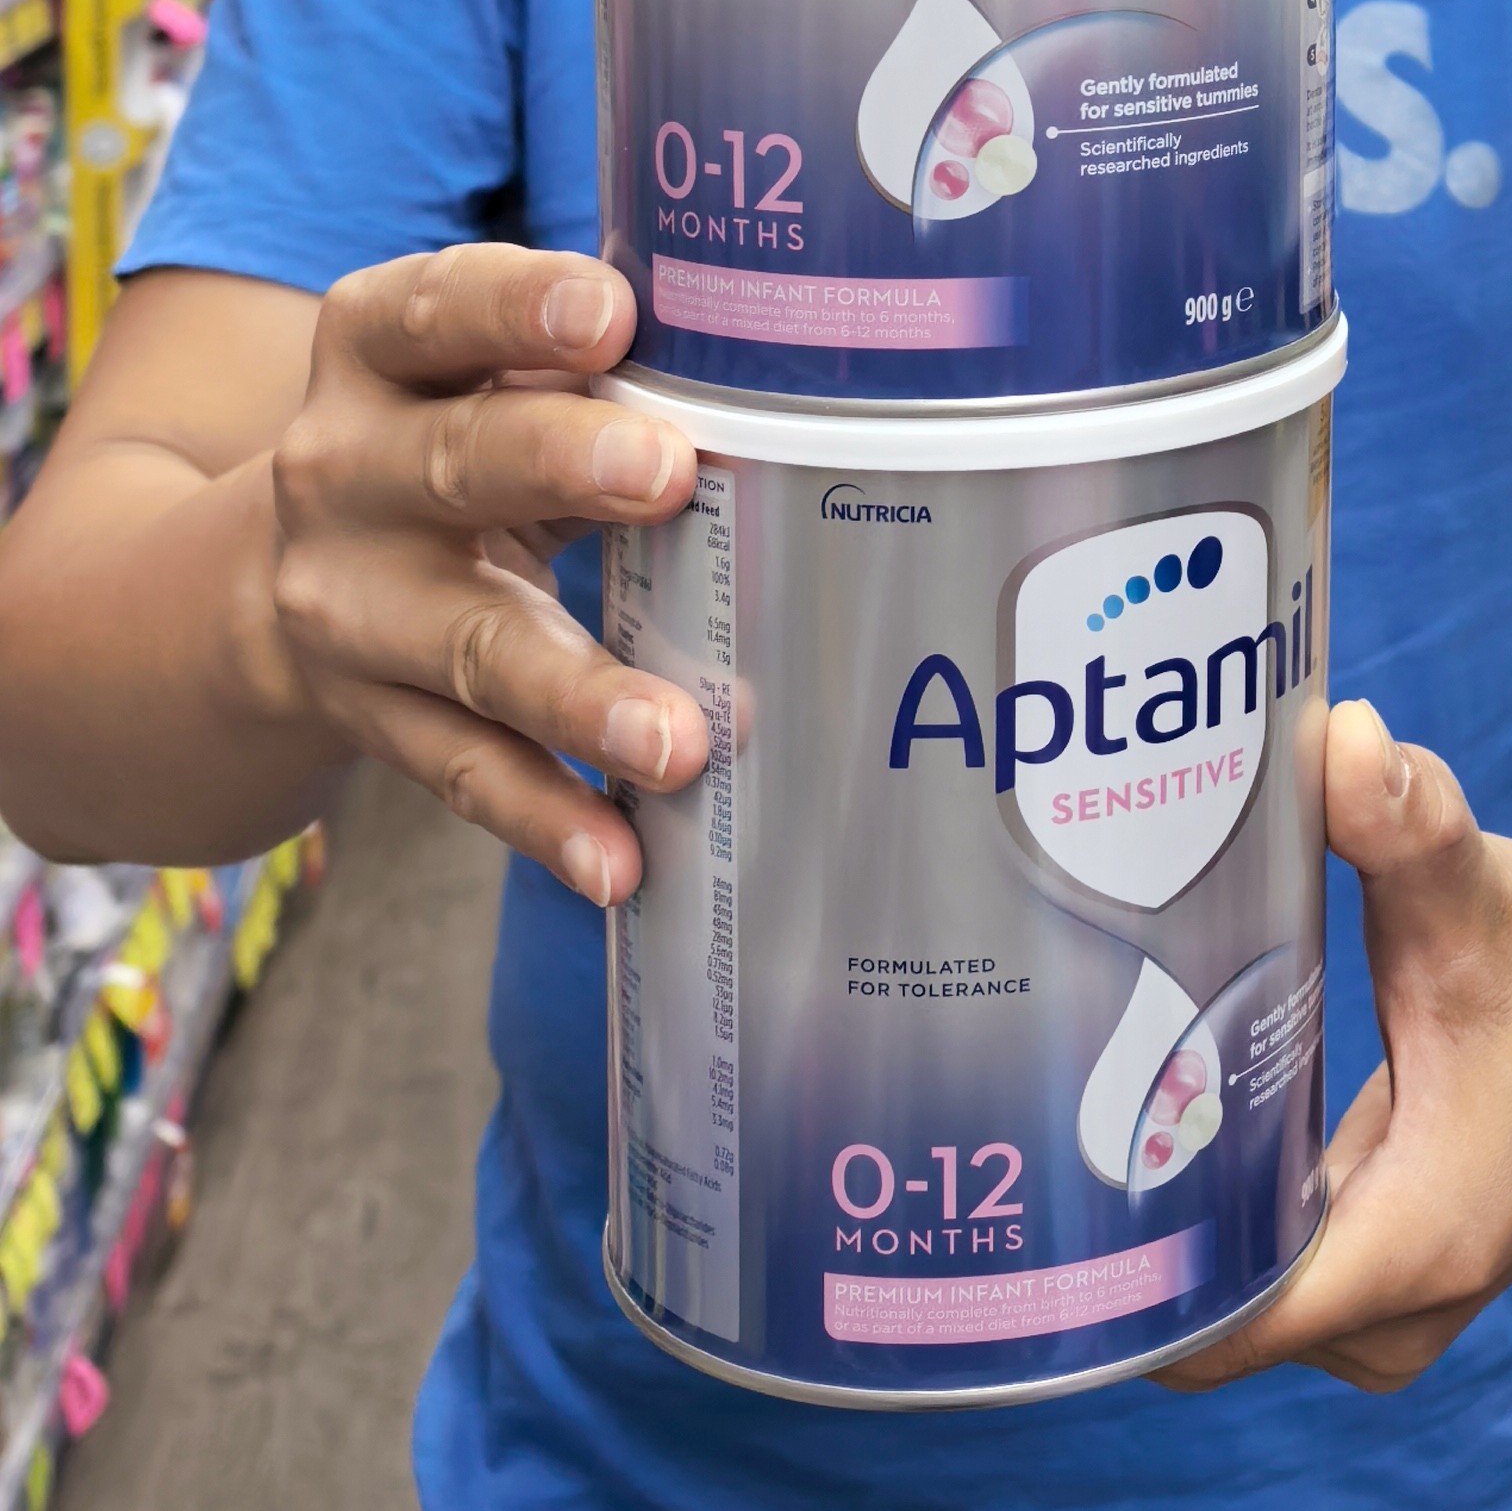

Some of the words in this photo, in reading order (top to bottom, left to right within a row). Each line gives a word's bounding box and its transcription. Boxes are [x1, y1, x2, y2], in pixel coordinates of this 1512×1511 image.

[1080, 75, 1145, 96] Gently
[1148, 61, 1239, 90] formulated
[1080, 102, 1109, 120] for
[1114, 94, 1193, 117] sensitive
[1196, 83, 1259, 108] tummies
[1080, 132, 1182, 157] Scientifically
[1080, 152, 1170, 176] researched
[1175, 140, 1249, 167] ingredients
[655, 121, 804, 214] 0-12
[658, 206, 805, 251] MONTHS
[658, 264, 735, 296] PREMIUM
[740, 279, 816, 304] INFANT
[824, 286, 942, 307] FORMULA
[708, 311, 720, 324] of
[732, 316, 770, 333] mixed
[773, 320, 799, 334] diet
[802, 323, 836, 336] from
[841, 325, 870, 337] 6-12
[874, 325, 931, 338] months
[722, 299, 782, 319] complete
[785, 305, 818, 321] from
[821, 307, 855, 322] birth
[860, 310, 875, 322] to
[879, 311, 889, 323] 6
[893, 310, 955, 325] months,
[1185, 293, 1218, 325] 900
[1222, 294, 1232, 322] g
[697, 476, 725, 492] TION
[830, 501, 932, 524] NUTRICIA
[889, 565, 1313, 795] Aptamil
[1051, 747, 1245, 825] SENSITIVE
[848, 957, 996, 975] FORMULATED
[848, 981, 890, 997] FOR
[898, 978, 1031, 997] TOLERANCE
[1250, 1001, 1286, 1037] Gently
[1250, 1038, 1267, 1059] for
[831, 1142, 1024, 1220] 0-12
[835, 1224, 1024, 1255] MONTHS
[834, 1282, 942, 1305] PREMIUM
[951, 1279, 1035, 1303] INFANT
[1044, 1254, 1151, 1294] FORMULA
[834, 1304, 923, 1322] Nutritionally
[927, 1305, 998, 1322] complete
[1000, 1300, 1037, 1316] from
[1040, 1292, 1075, 1311] birth
[1079, 1290, 1093, 1303] to
[1096, 1286, 1105, 1299] 6
[834, 1321, 850, 1331] or
[852, 1322, 869, 1333] as
[873, 1321, 903, 1336] part
[907, 1321, 924, 1334] of
[925, 1325, 934, 1334] a
[940, 1320, 984, 1333] mixed
[988, 1316, 1016, 1332] diet
[1020, 1312, 1056, 1329] from
[1059, 1305, 1088, 1320] 6-12
[1092, 1290, 1143, 1313] months
